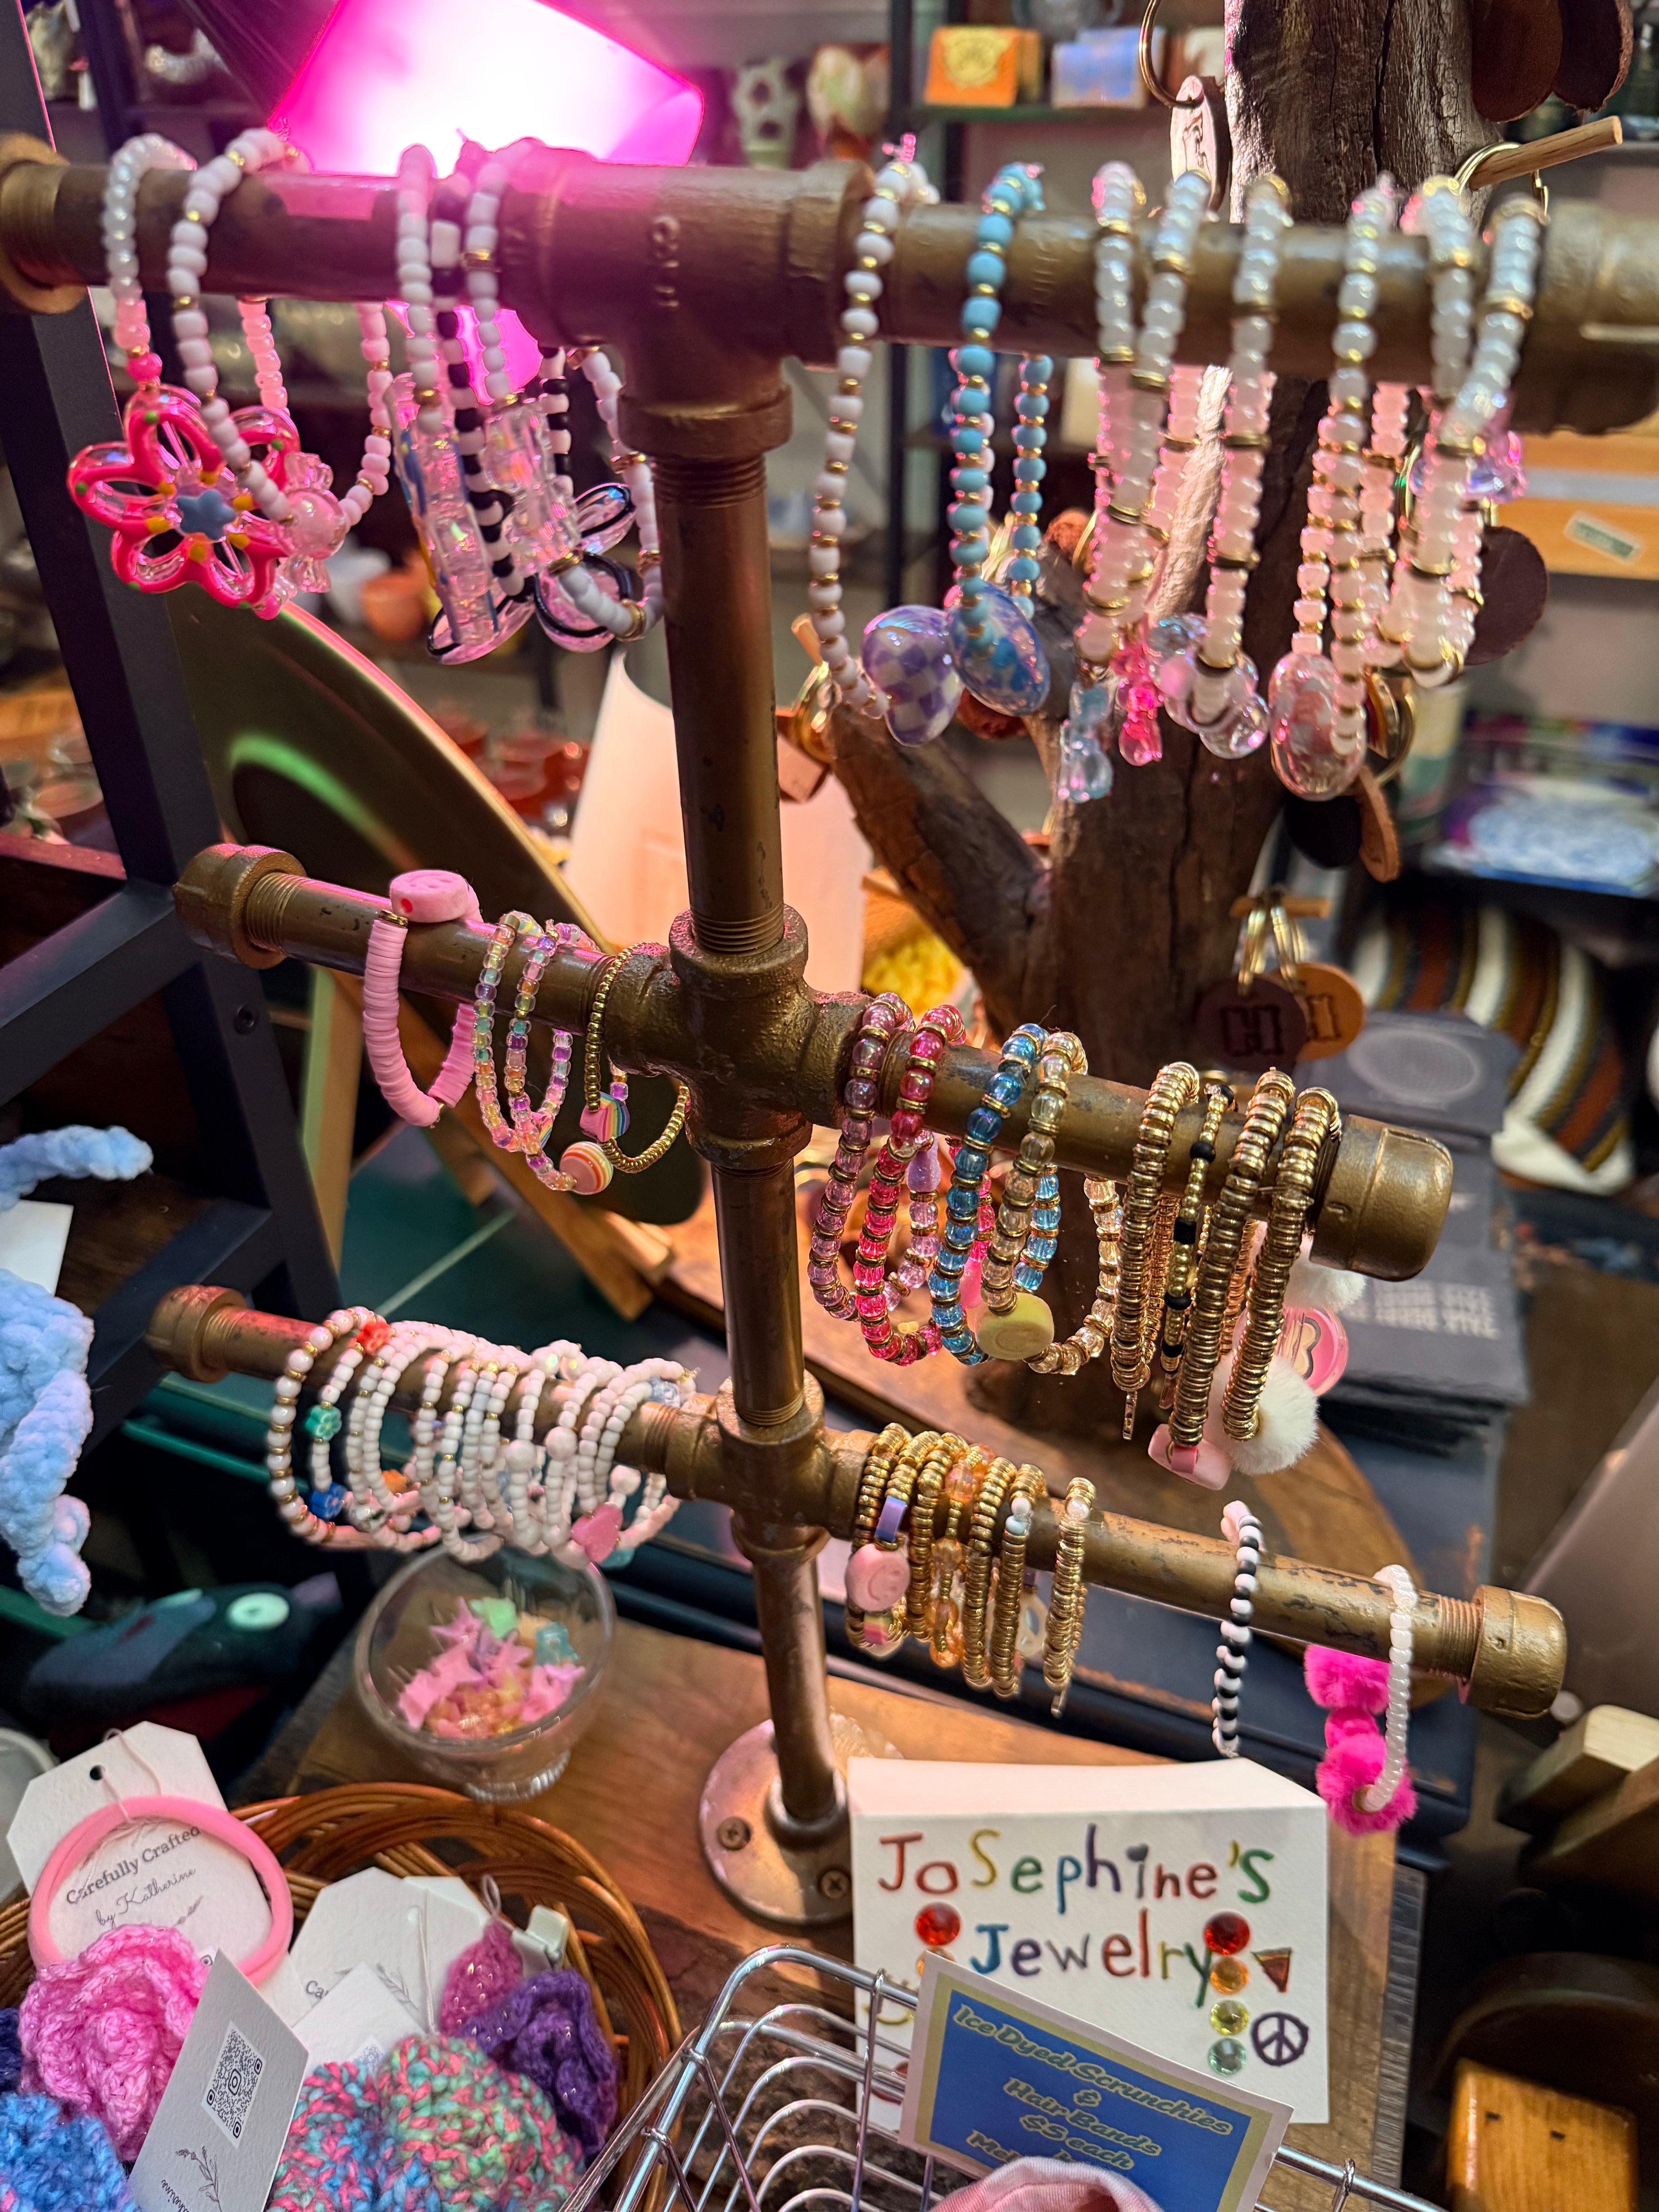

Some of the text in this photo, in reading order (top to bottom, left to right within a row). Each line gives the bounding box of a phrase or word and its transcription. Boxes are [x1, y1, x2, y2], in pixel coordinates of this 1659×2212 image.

[66, 1826, 201, 1904] Carefully Crafted
[95, 1868, 196, 1931] by Katherine
[969, 1906, 1213, 2009] Jewelry
[953, 2003, 1233, 2135] Ice Dyed Scrunchies
[1073, 2089, 1102, 2107] &
[1003, 2077, 1162, 2156] Hair Bands
[1065, 2137, 1135, 2170] each
